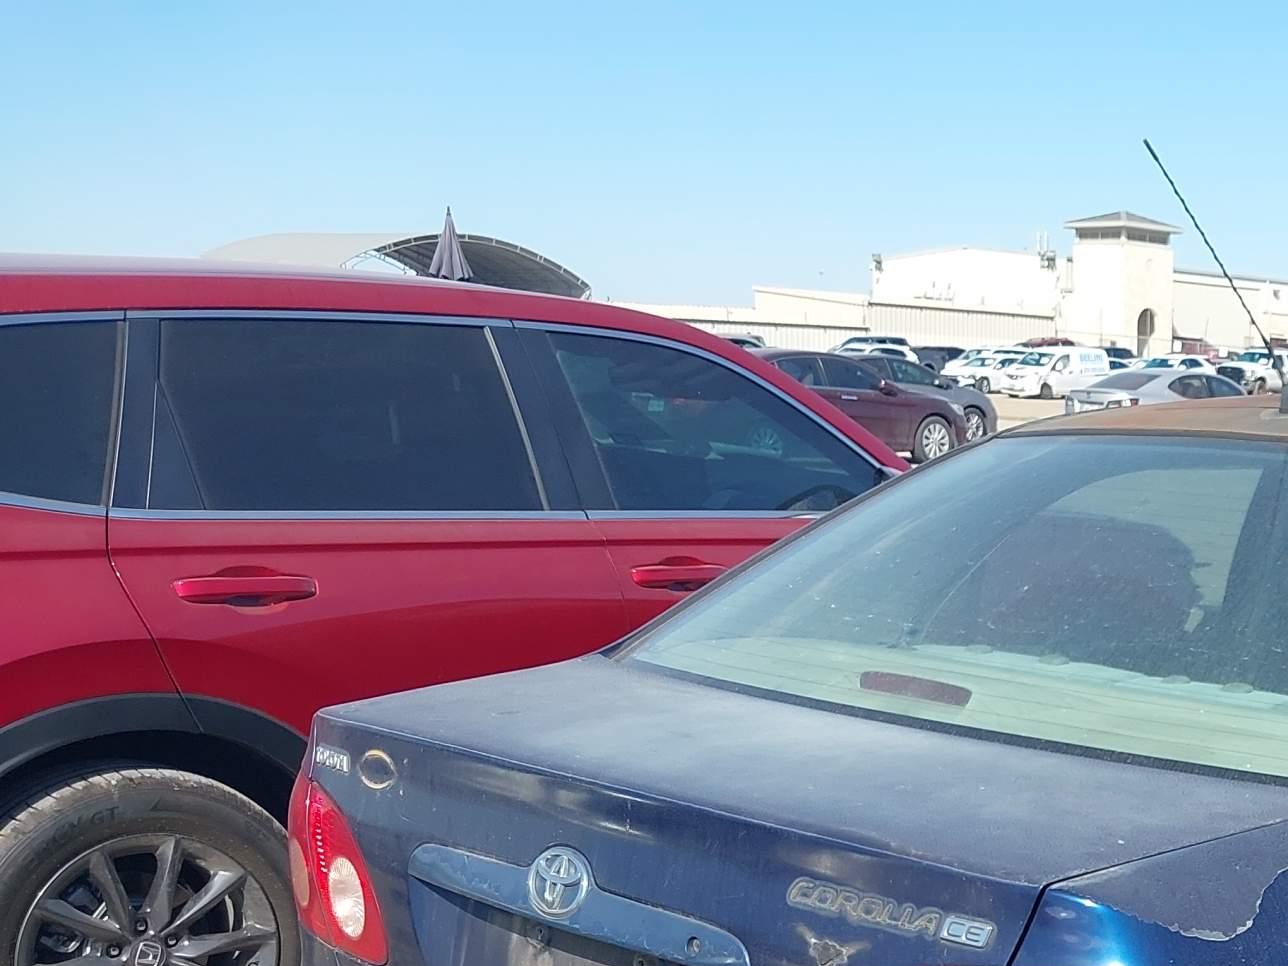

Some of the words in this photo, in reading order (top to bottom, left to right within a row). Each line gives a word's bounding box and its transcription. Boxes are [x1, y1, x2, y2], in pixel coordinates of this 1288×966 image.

[316, 746, 349, 773] TOYOTA
[789, 880, 942, 937] COROLLA
[945, 919, 988, 945] CE
